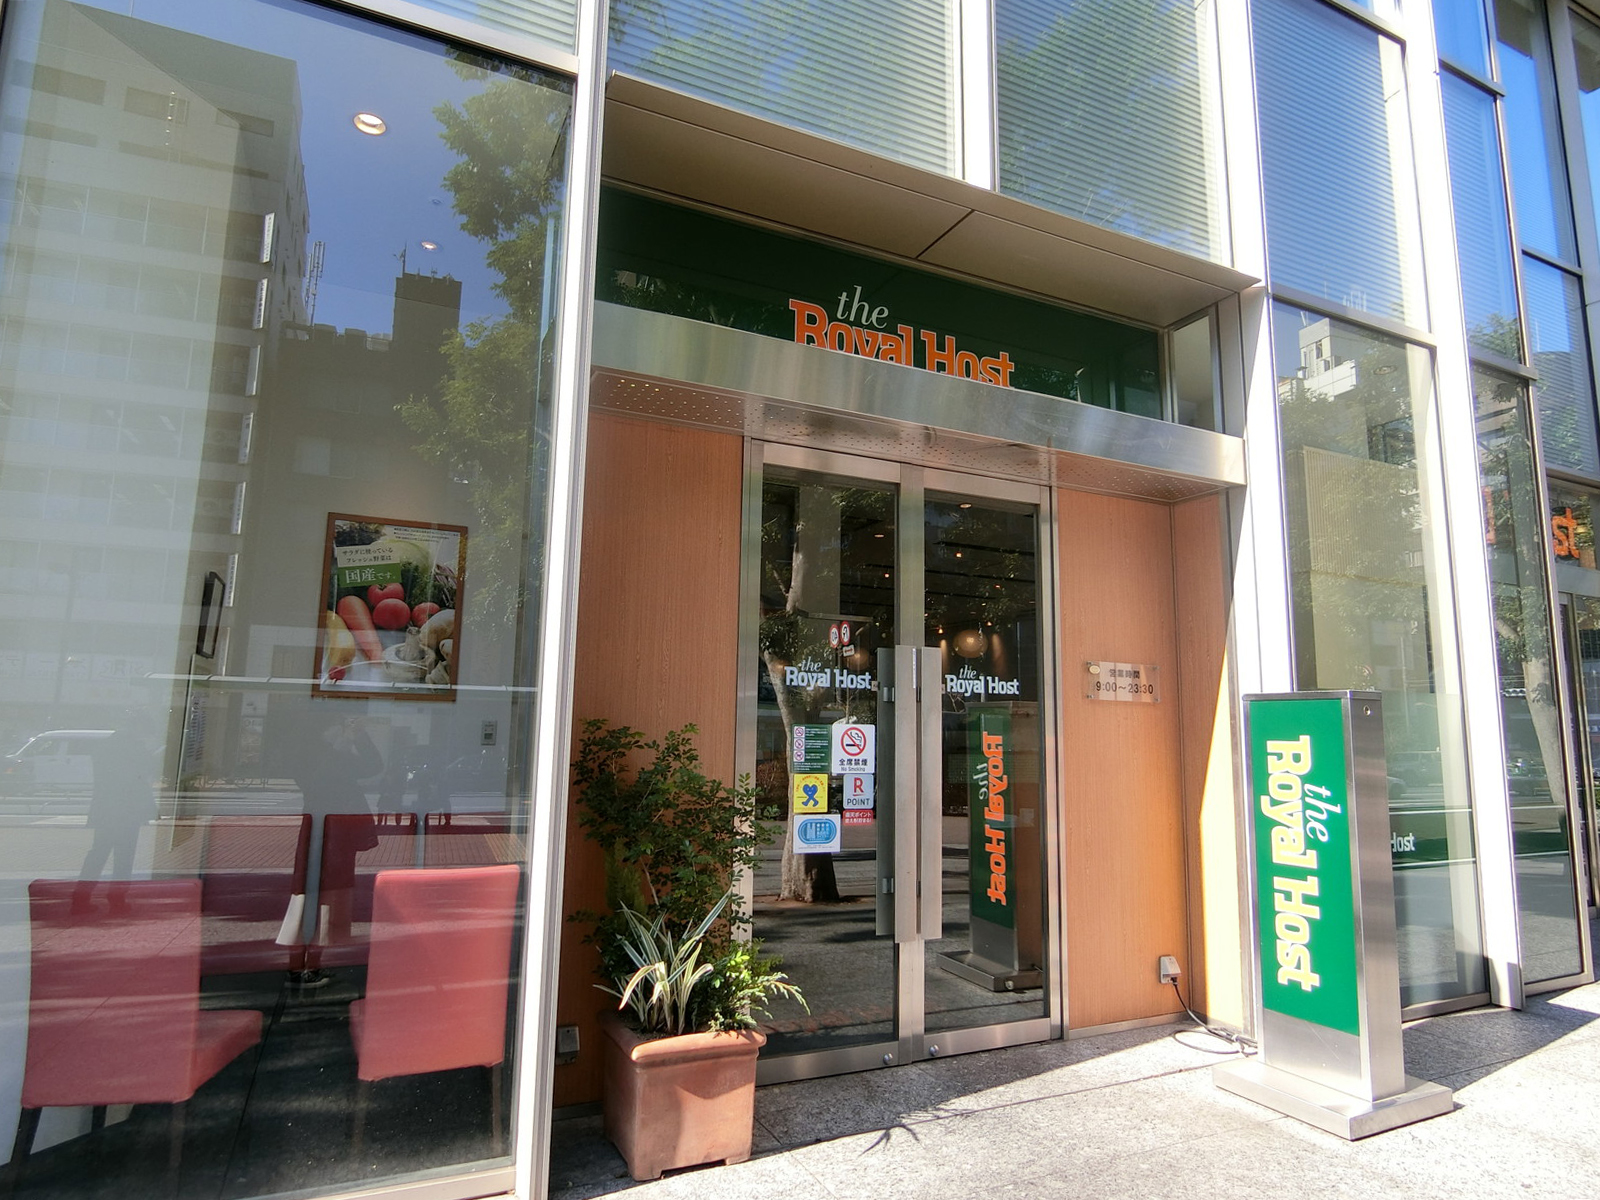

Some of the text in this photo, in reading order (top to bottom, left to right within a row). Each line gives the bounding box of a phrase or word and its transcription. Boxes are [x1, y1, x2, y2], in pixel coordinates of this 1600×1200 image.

[837, 284, 889, 328] the
[789, 298, 1014, 388] Royal Host
[801, 656, 822, 672] the
[959, 664, 977, 680] the
[1109, 669, 1140, 679] 営業時間
[784, 666, 872, 691] Royal Host
[945, 674, 1020, 697] Royal Host
[839, 758, 868, 766] 全席禁煙
[847, 798, 870, 806] POINT
[1304, 783, 1342, 843] the
[1261, 735, 1321, 992] Royal Host
